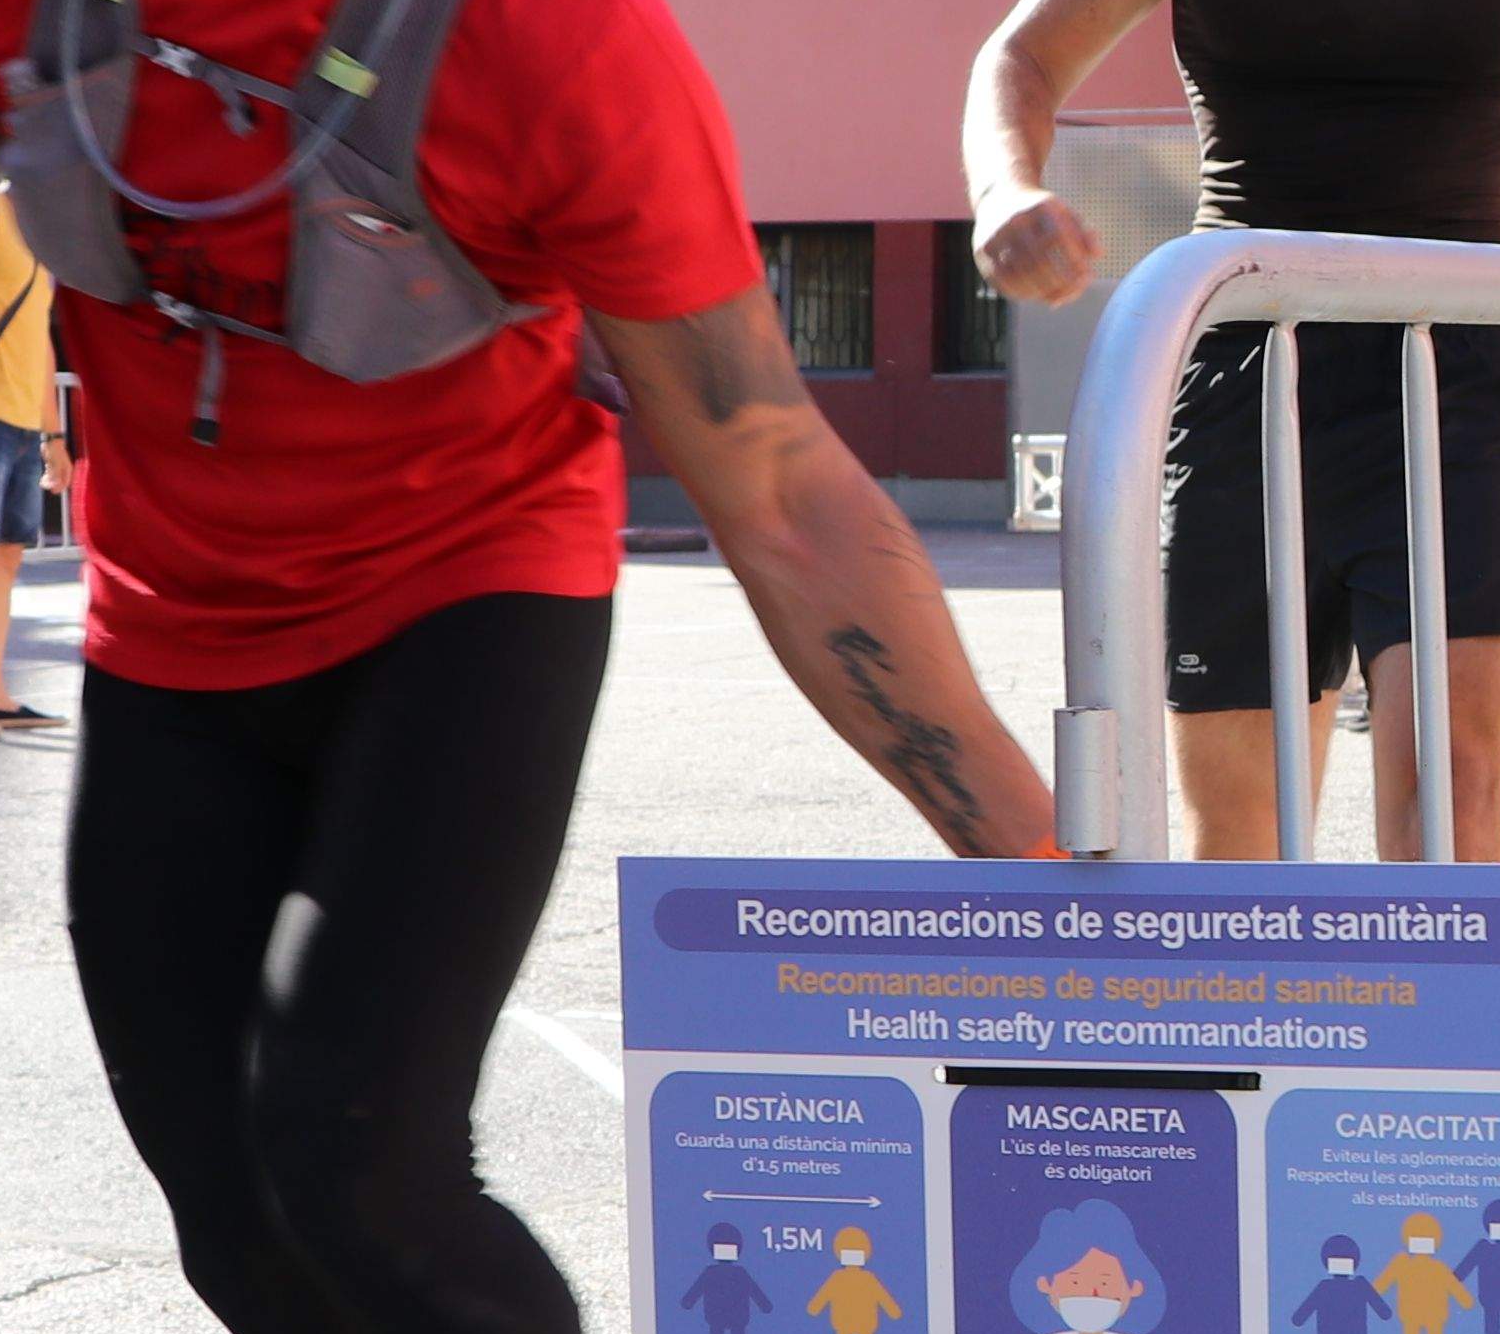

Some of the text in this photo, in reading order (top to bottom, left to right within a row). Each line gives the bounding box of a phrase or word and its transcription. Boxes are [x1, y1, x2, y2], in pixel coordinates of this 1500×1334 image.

[738, 900, 1487, 949] Recomanacions de seguretat sanitària
[779, 963, 1415, 1009] Recomanaciones de seguridad sanitaria
[848, 1008, 1368, 1051] Health saefty recommandations
[715, 1092, 864, 1123] DISTÀNCIA
[1008, 1105, 1185, 1133] MASCARETA
[1336, 1113, 1500, 1141] CAPACITAT
[675, 1132, 735, 1148] Guarda
[738, 1138, 769, 1149] una
[772, 1135, 847, 1152] distància
[1038, 1140, 1062, 1156] de
[1065, 1141, 1091, 1157] les
[1095, 1145, 1197, 1160] mascaretes
[783, 1160, 841, 1175] metres
[1323, 1148, 1371, 1163] Eviteu
[1374, 1150, 1397, 1164] les
[1068, 1164, 1152, 1184] obligatori
[762, 1226, 823, 1252] 1,5M
